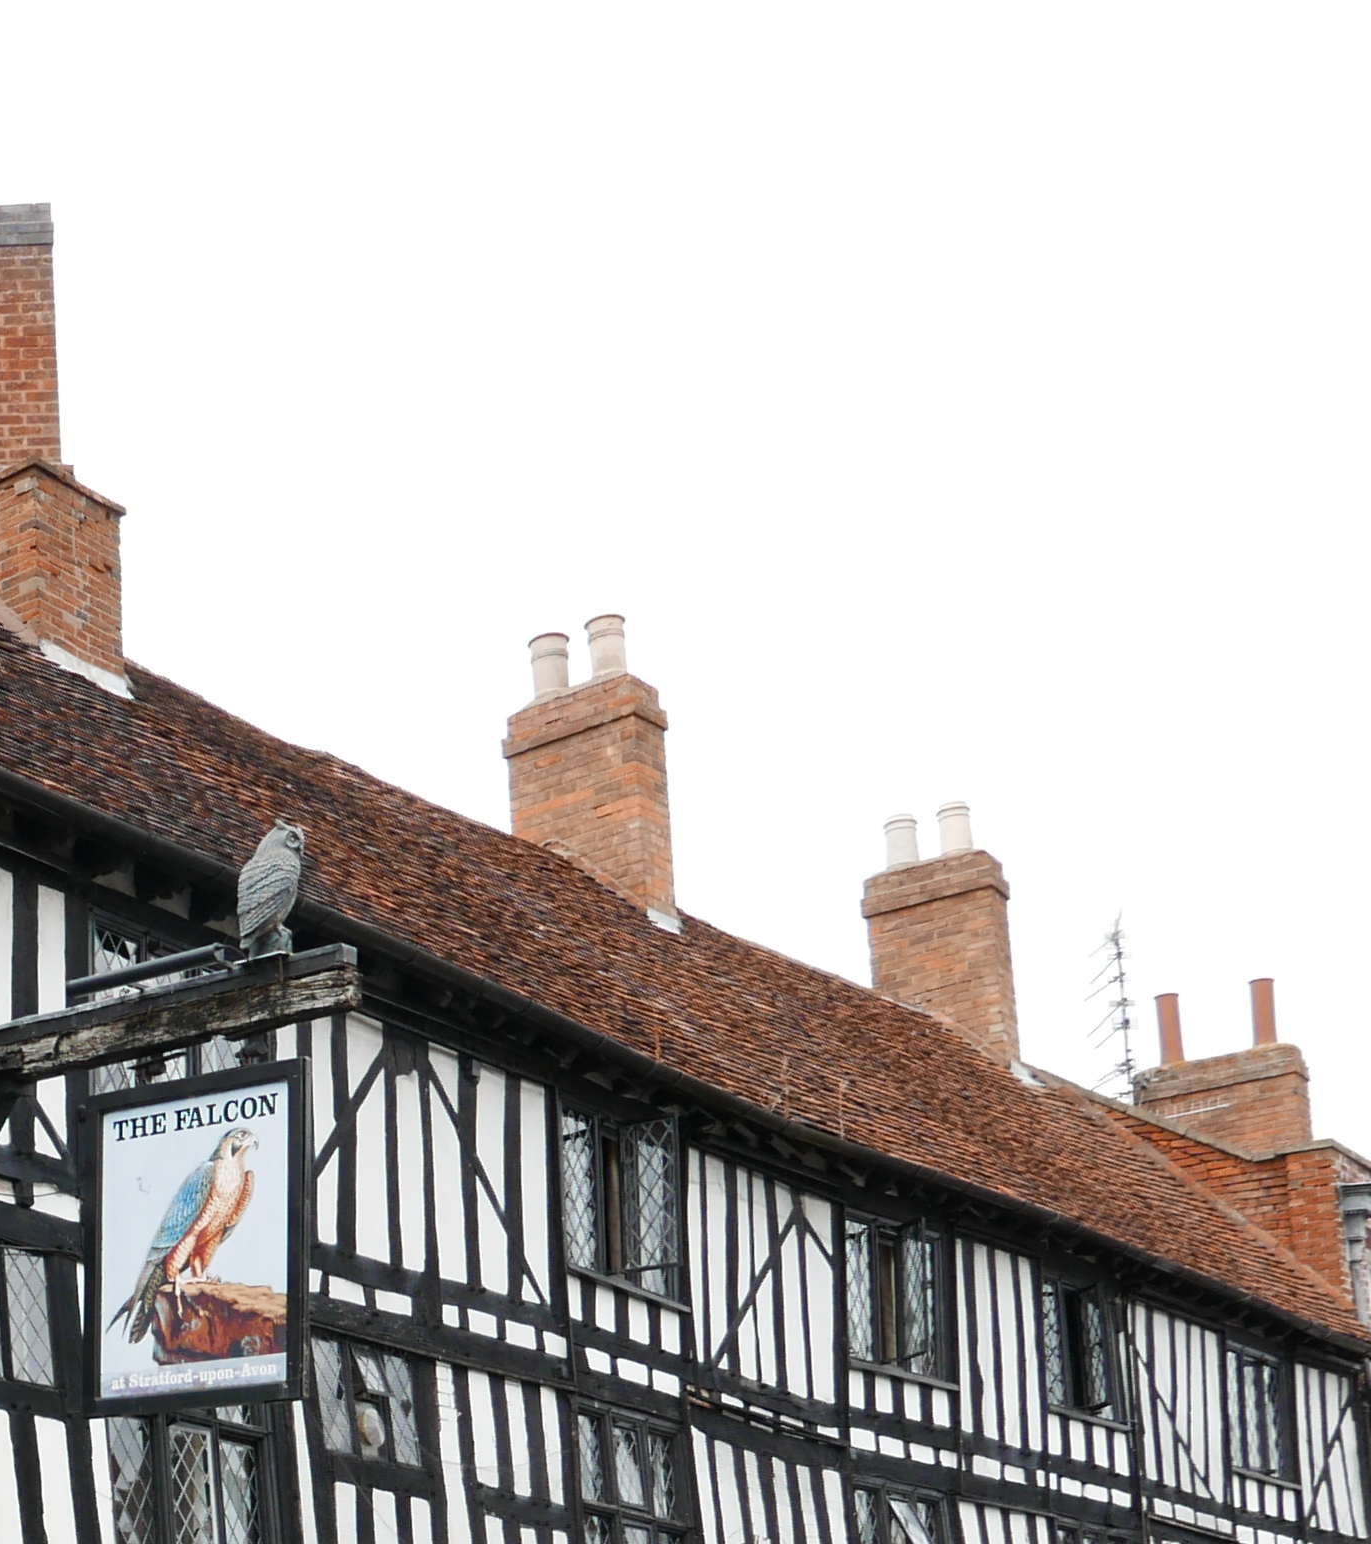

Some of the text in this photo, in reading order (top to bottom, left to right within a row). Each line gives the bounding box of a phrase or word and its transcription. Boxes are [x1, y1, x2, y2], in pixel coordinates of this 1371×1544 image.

[113, 1093, 279, 1141] THE FALCON
[111, 1362, 278, 1391] at Stratford-upon-Avon
